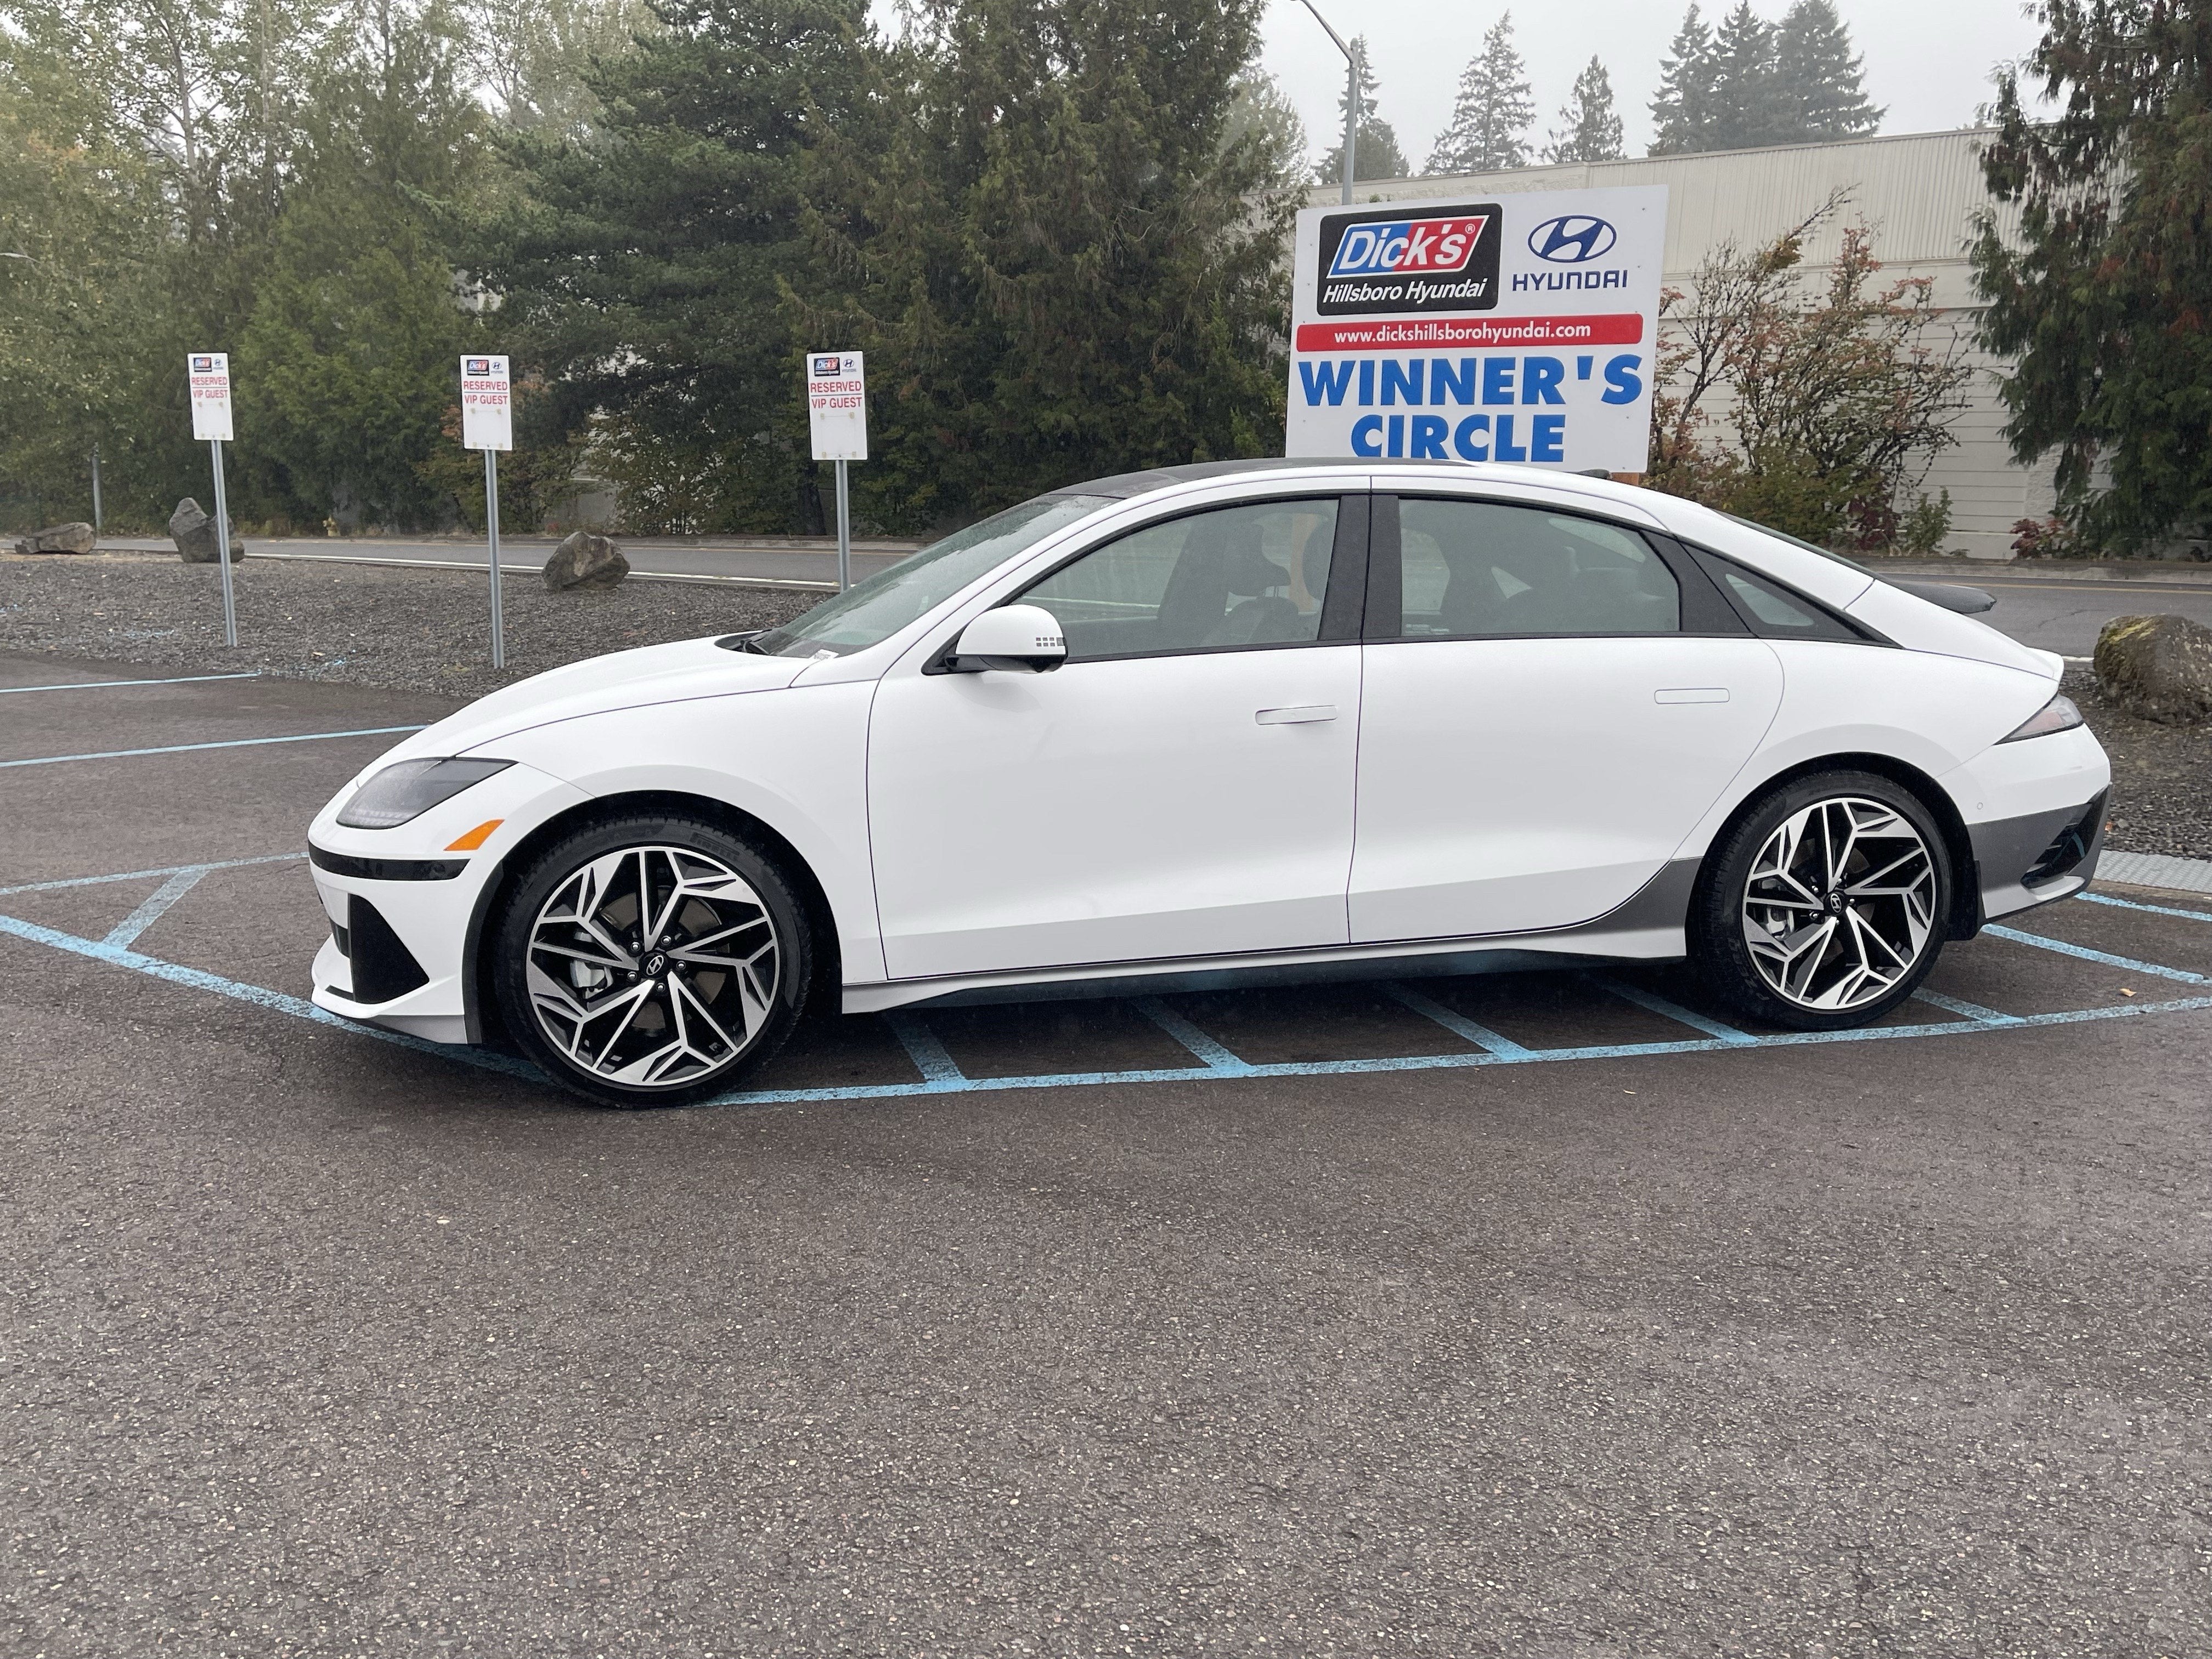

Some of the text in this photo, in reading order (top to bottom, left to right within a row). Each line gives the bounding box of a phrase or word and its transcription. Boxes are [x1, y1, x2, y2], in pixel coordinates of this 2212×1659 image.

[1338, 224, 1466, 270] Dick's
[1513, 270, 1628, 291] HYUNDAI
[1323, 277, 1488, 304] Hillsboro Hyundai
[1334, 320, 1591, 344] www.dickshillsborohyundai.com
[191, 376, 227, 385] RESERVED
[464, 381, 507, 391] RESERVED
[810, 381, 862, 393] RESERVED
[1298, 354, 1643, 407] WINNER'S
[193, 390, 228, 398] VIP GUEST
[465, 395, 508, 405] VIP GUEST
[811, 397, 862, 409] VIP GUEST
[1351, 414, 1566, 462] CIRCLE
